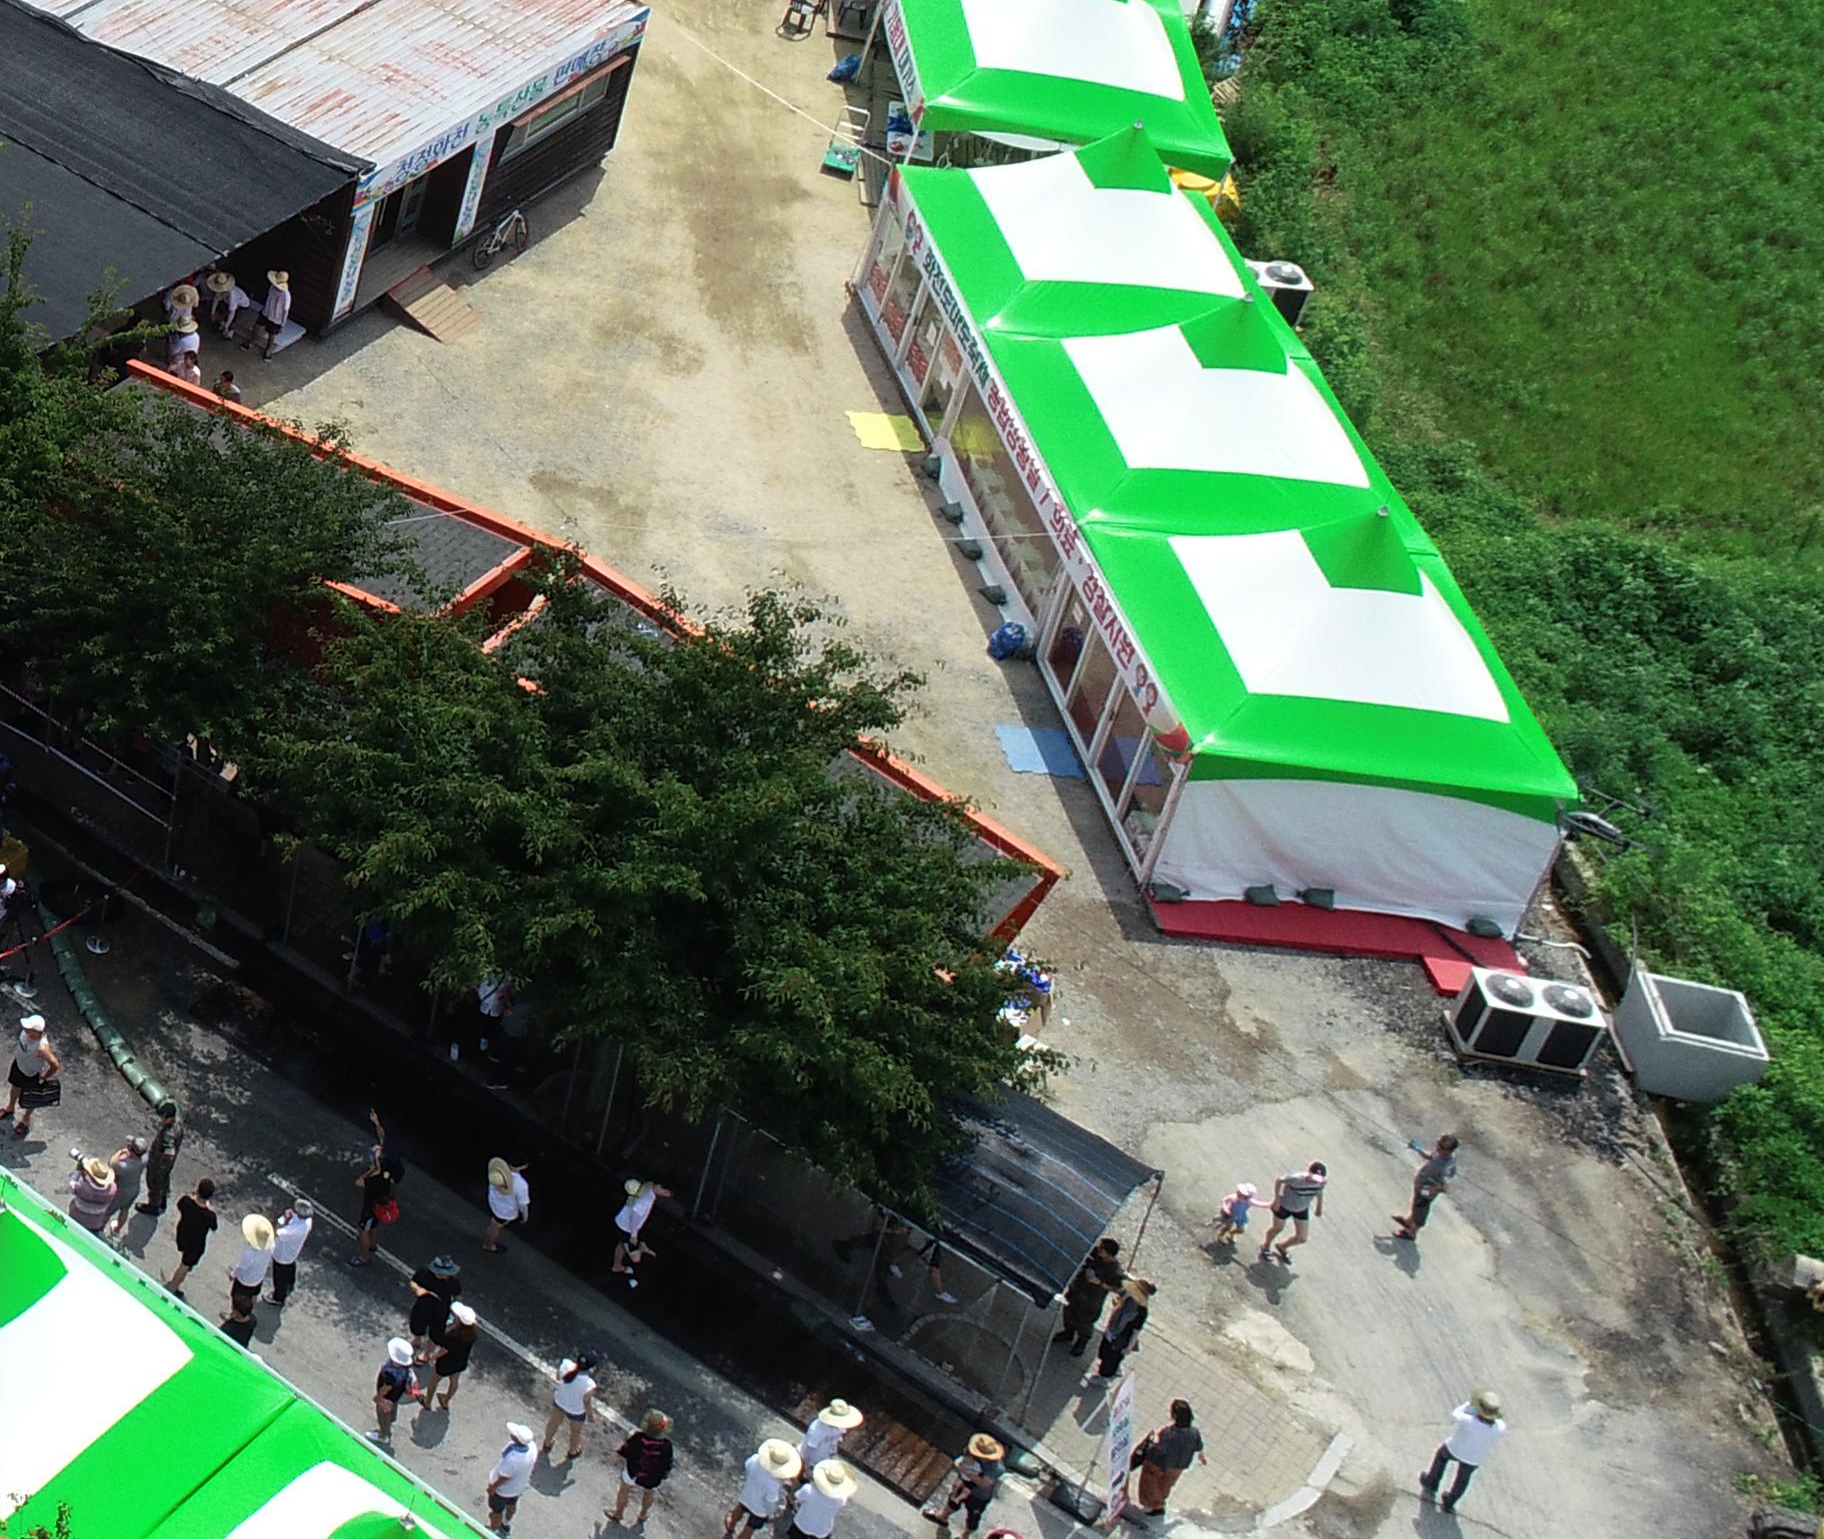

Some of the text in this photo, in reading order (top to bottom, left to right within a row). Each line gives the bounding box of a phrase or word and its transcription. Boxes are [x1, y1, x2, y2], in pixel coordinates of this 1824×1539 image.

[394, 38, 611, 186] 청정화천 농특산물 판매장
[921, 245, 992, 391] 화천토마토축제
